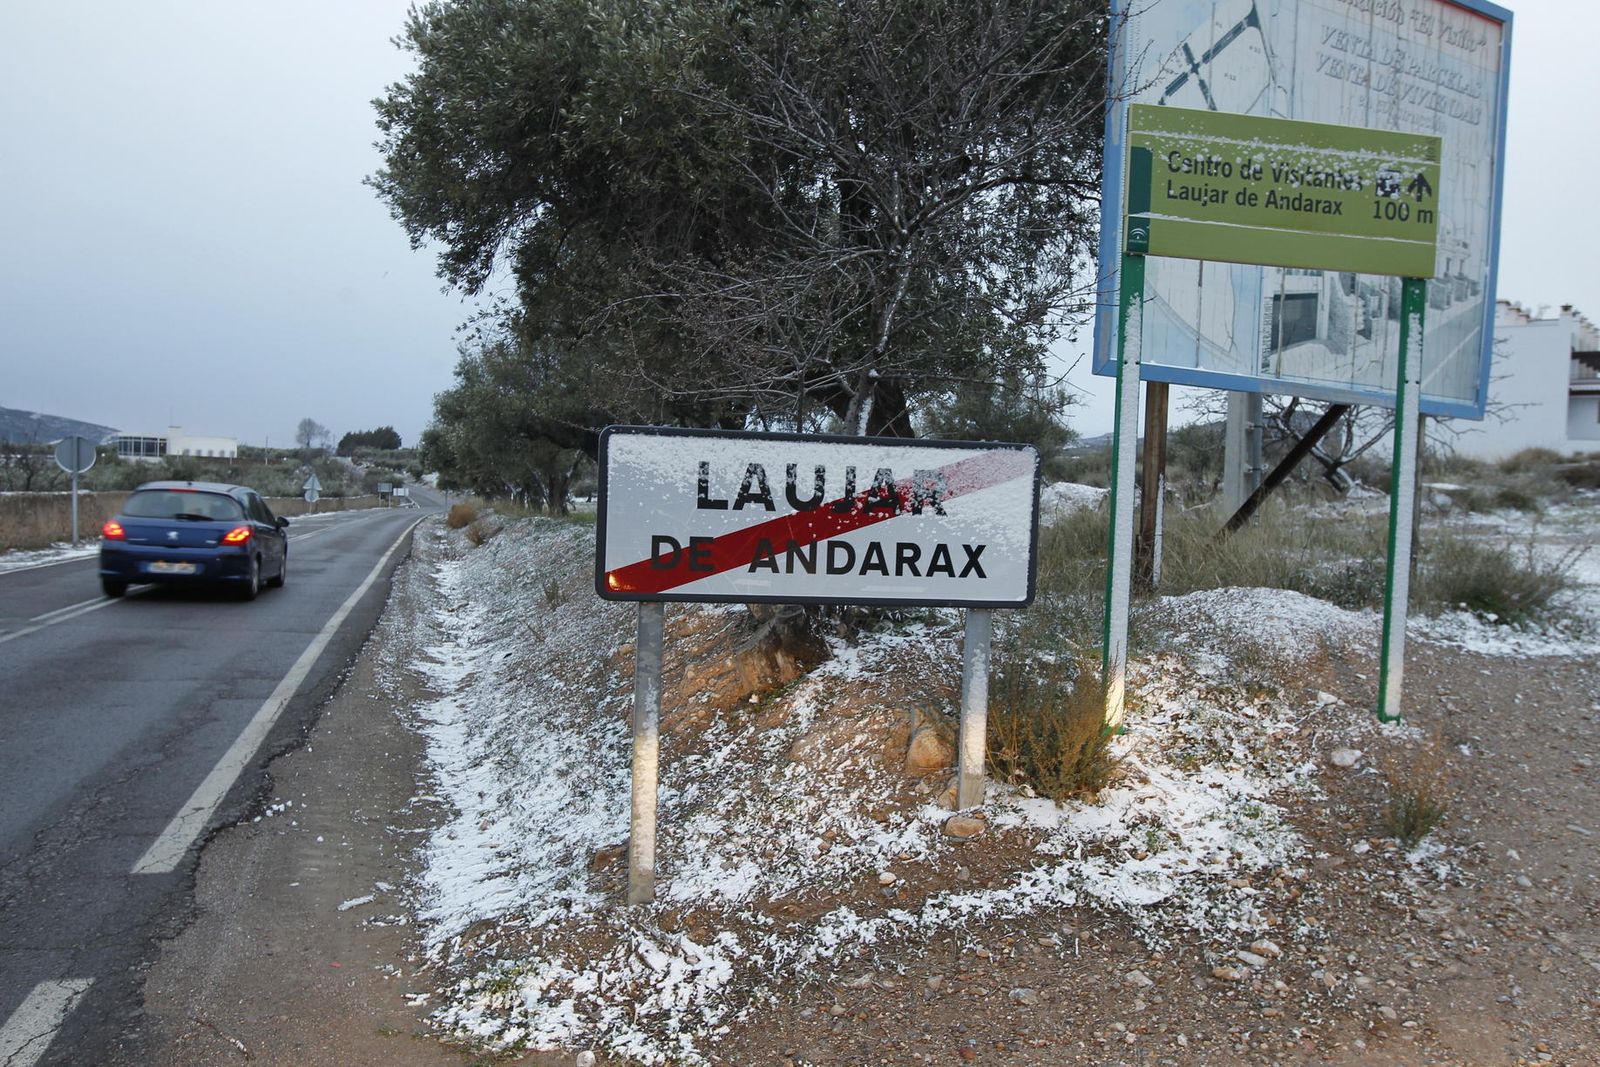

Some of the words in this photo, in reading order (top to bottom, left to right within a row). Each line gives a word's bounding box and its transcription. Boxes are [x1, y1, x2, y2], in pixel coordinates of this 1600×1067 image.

[1321, 23, 1377, 62] VENTA
[1378, 45, 1402, 73] DE
[1402, 53, 1482, 99] PARCELAS
[1315, 50, 1371, 87] VENTA
[1372, 71, 1399, 97] DE
[1399, 81, 1482, 126] VIVIENDAS
[1167, 150, 1233, 178] Centro
[1239, 158, 1264, 182] de
[1272, 160, 1364, 193] Visitantes
[1166, 179, 1229, 207] Laujar
[1235, 187, 1259, 208] de
[1264, 189, 1343, 216] Andarax
[1372, 199, 1410, 222] 100
[1416, 208, 1433, 224] m
[696, 460, 948, 518] LAUJAR
[650, 534, 716, 573] DE
[747, 536, 988, 579] ANDARAX
